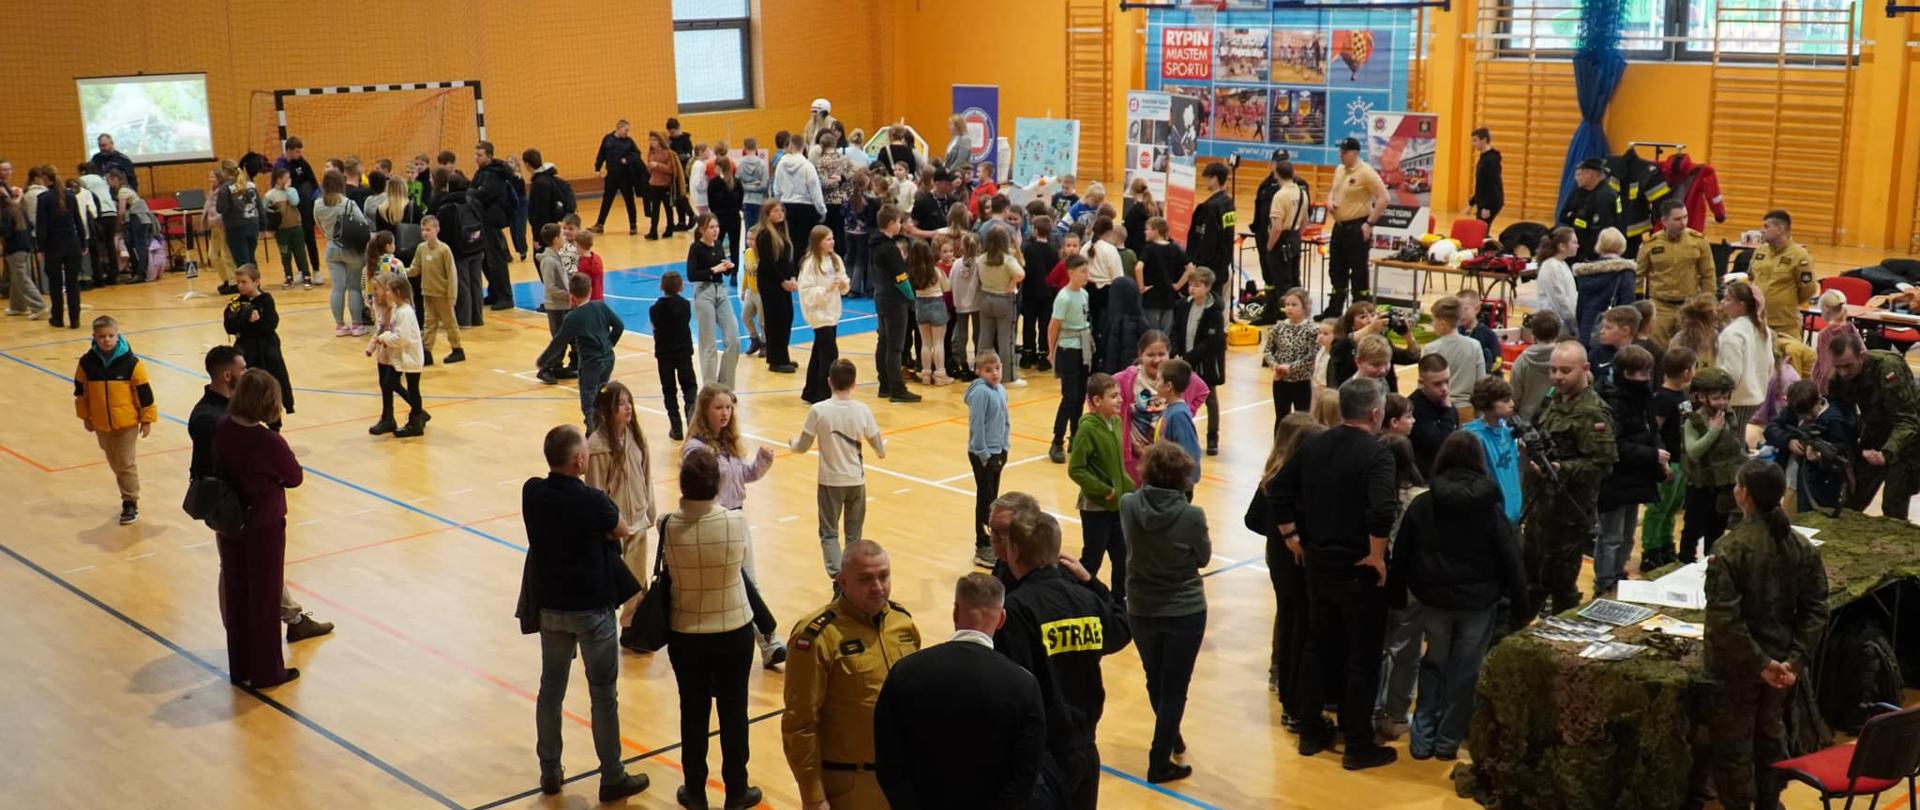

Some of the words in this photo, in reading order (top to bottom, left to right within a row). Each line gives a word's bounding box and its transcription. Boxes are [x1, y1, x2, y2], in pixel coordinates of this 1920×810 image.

[1166, 30, 1209, 46] RYPIN
[1166, 47, 1208, 60] MIASTEM
[1166, 62, 1208, 77] SPORTU
